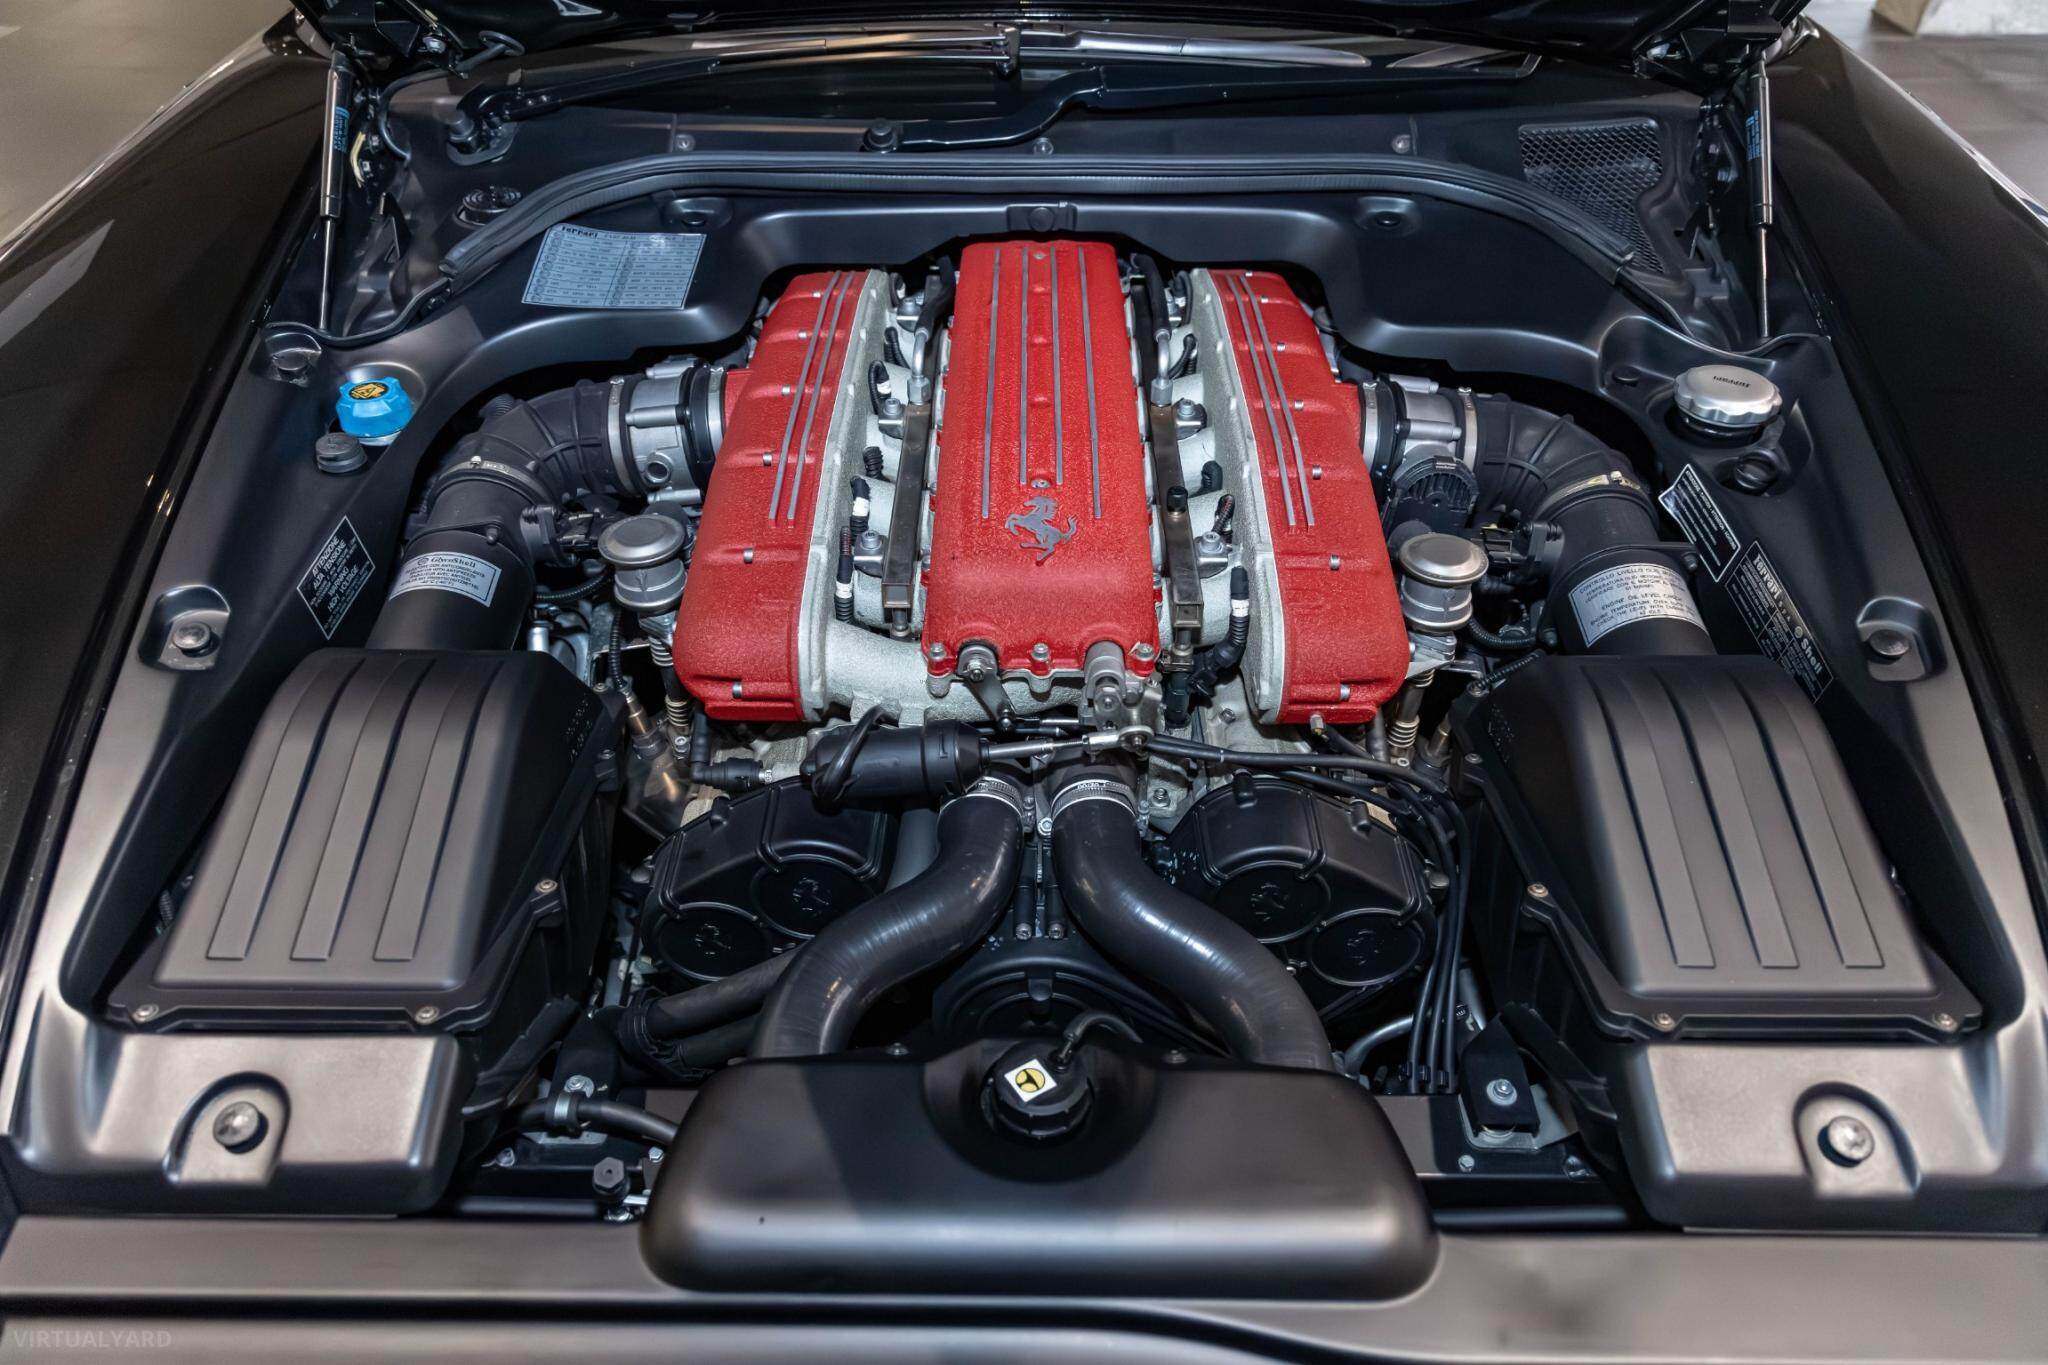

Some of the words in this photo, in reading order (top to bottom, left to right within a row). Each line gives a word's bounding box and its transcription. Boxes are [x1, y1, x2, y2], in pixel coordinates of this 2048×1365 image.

[561, 226, 598, 239] Ferrari
[312, 536, 339, 577] ATTENZIONE
[313, 573, 325, 590] ALTA
[323, 540, 347, 572] TENSIONE
[1580, 573, 1614, 594] CONTROLLO
[1752, 553, 1782, 599] Ferrari
[1801, 638, 1823, 674] Shell
